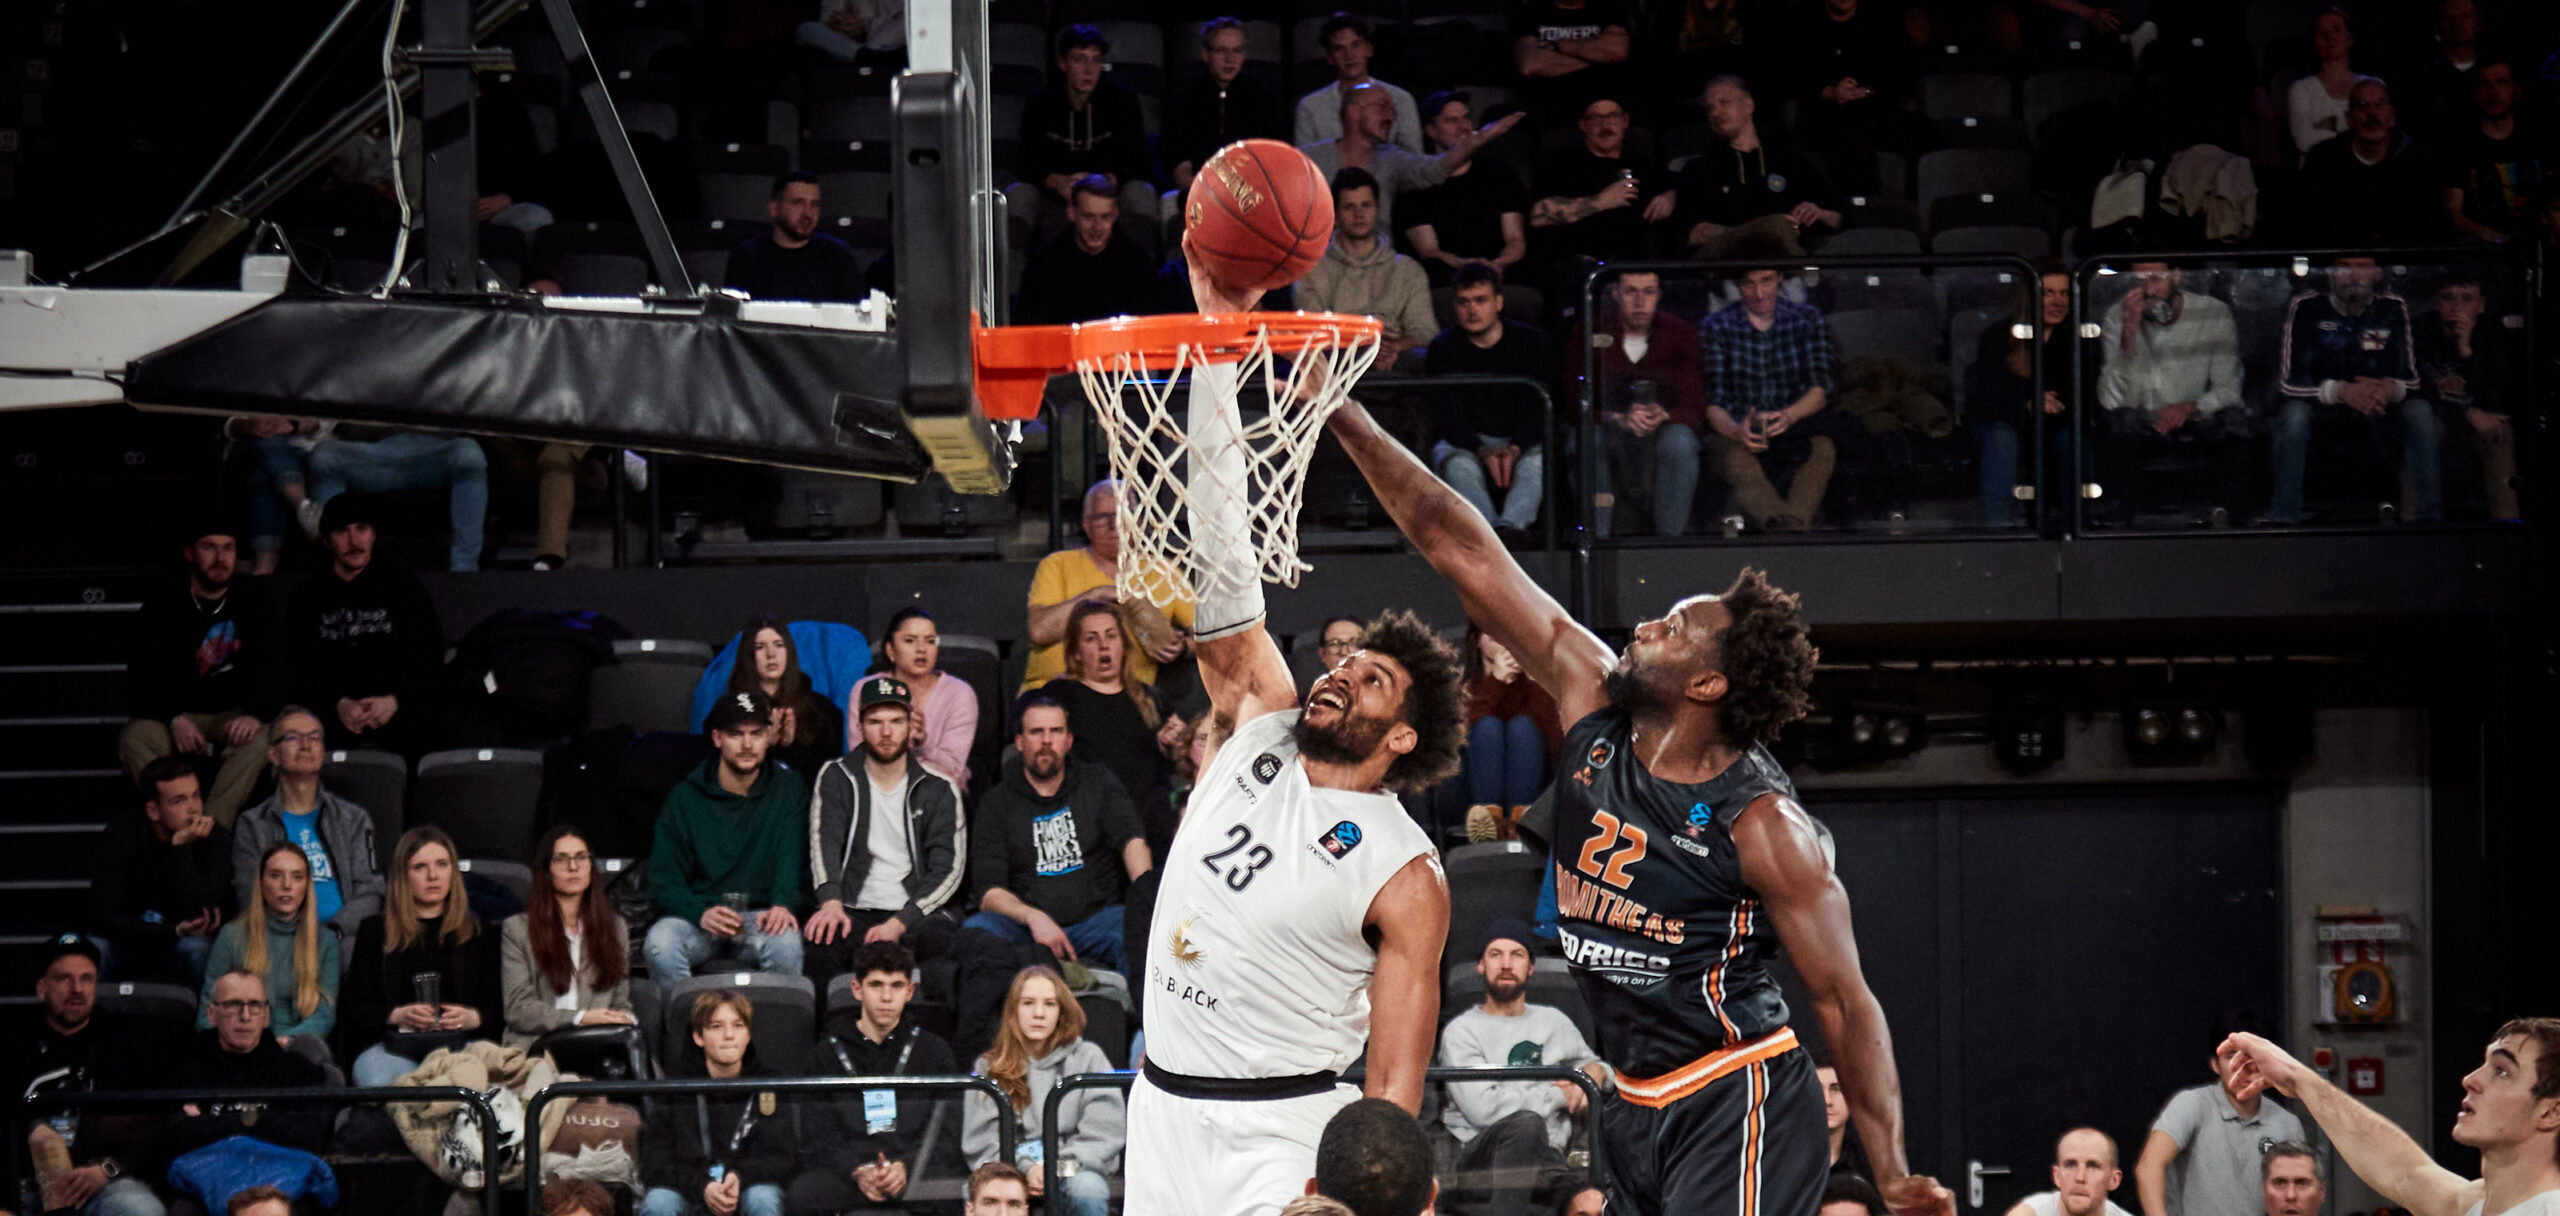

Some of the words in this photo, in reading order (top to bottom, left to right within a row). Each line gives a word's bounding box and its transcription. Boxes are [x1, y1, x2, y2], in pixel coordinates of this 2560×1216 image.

[1538, 25, 1601, 41] TOWERS
[1200, 822, 1276, 894] 23
[1577, 809, 1648, 890] 22
